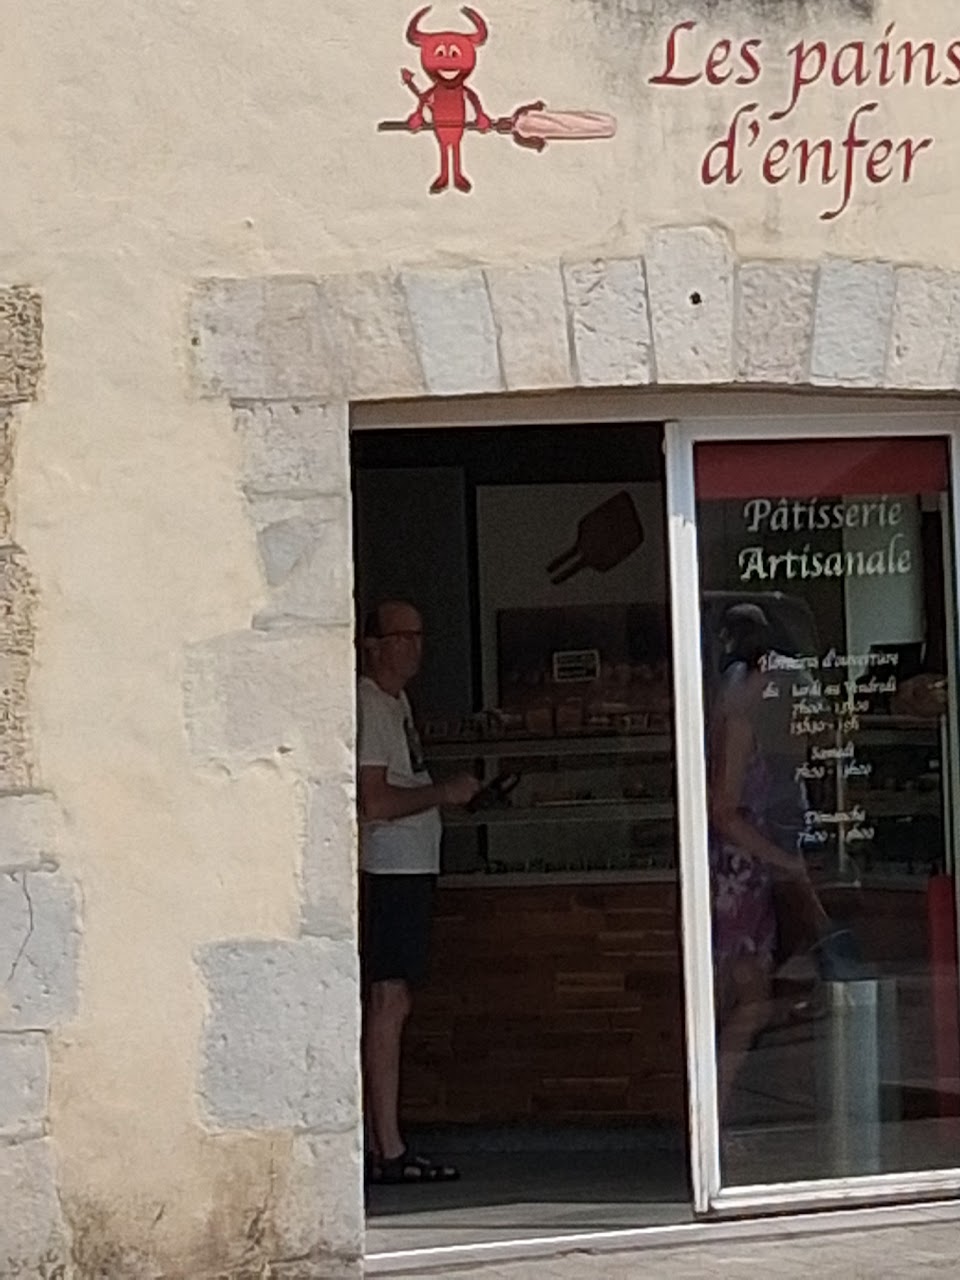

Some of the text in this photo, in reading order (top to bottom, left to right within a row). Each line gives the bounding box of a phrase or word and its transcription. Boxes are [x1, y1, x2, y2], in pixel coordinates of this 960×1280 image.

[647, 20, 763, 86] Les
[701, 102, 934, 221] d'enfer
[743, 495, 903, 532] Pâtisserie
[738, 533, 912, 580] Artisanale
